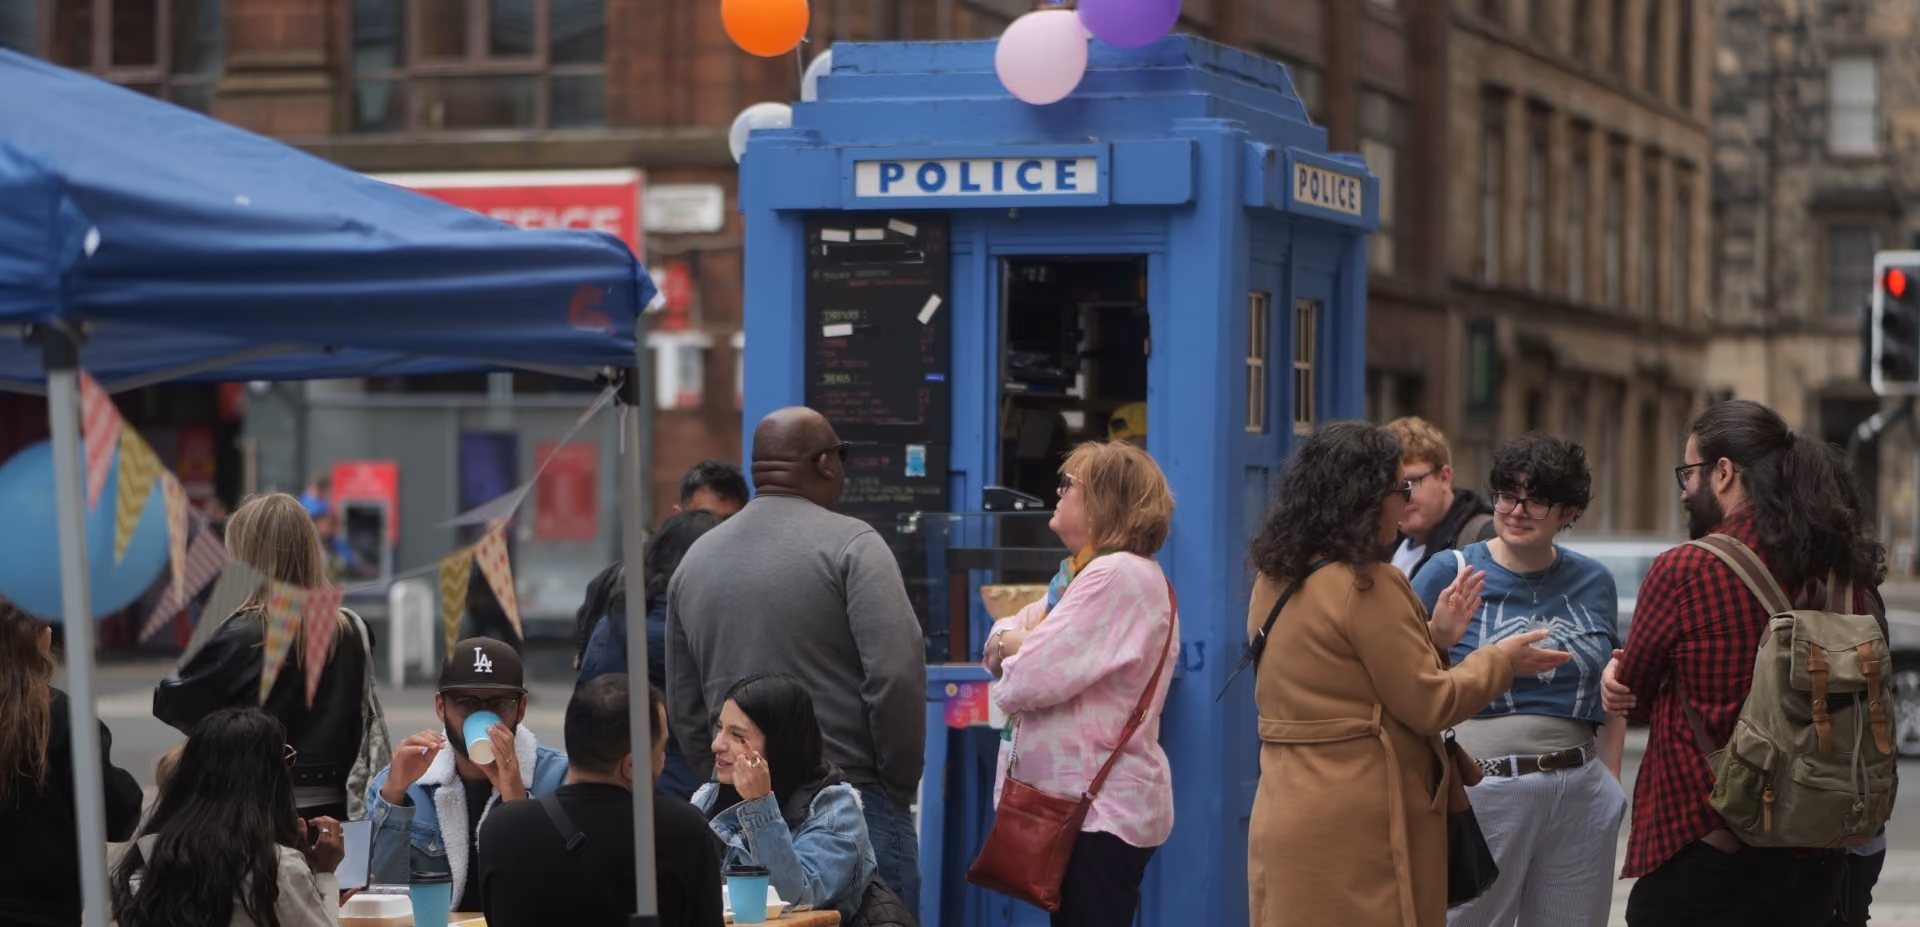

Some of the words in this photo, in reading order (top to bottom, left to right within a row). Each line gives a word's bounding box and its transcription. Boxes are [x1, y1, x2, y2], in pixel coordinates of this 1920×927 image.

[879, 160, 1077, 193] POLICE
[1299, 168, 1355, 210] POLICE
[473, 647, 493, 673] LA
